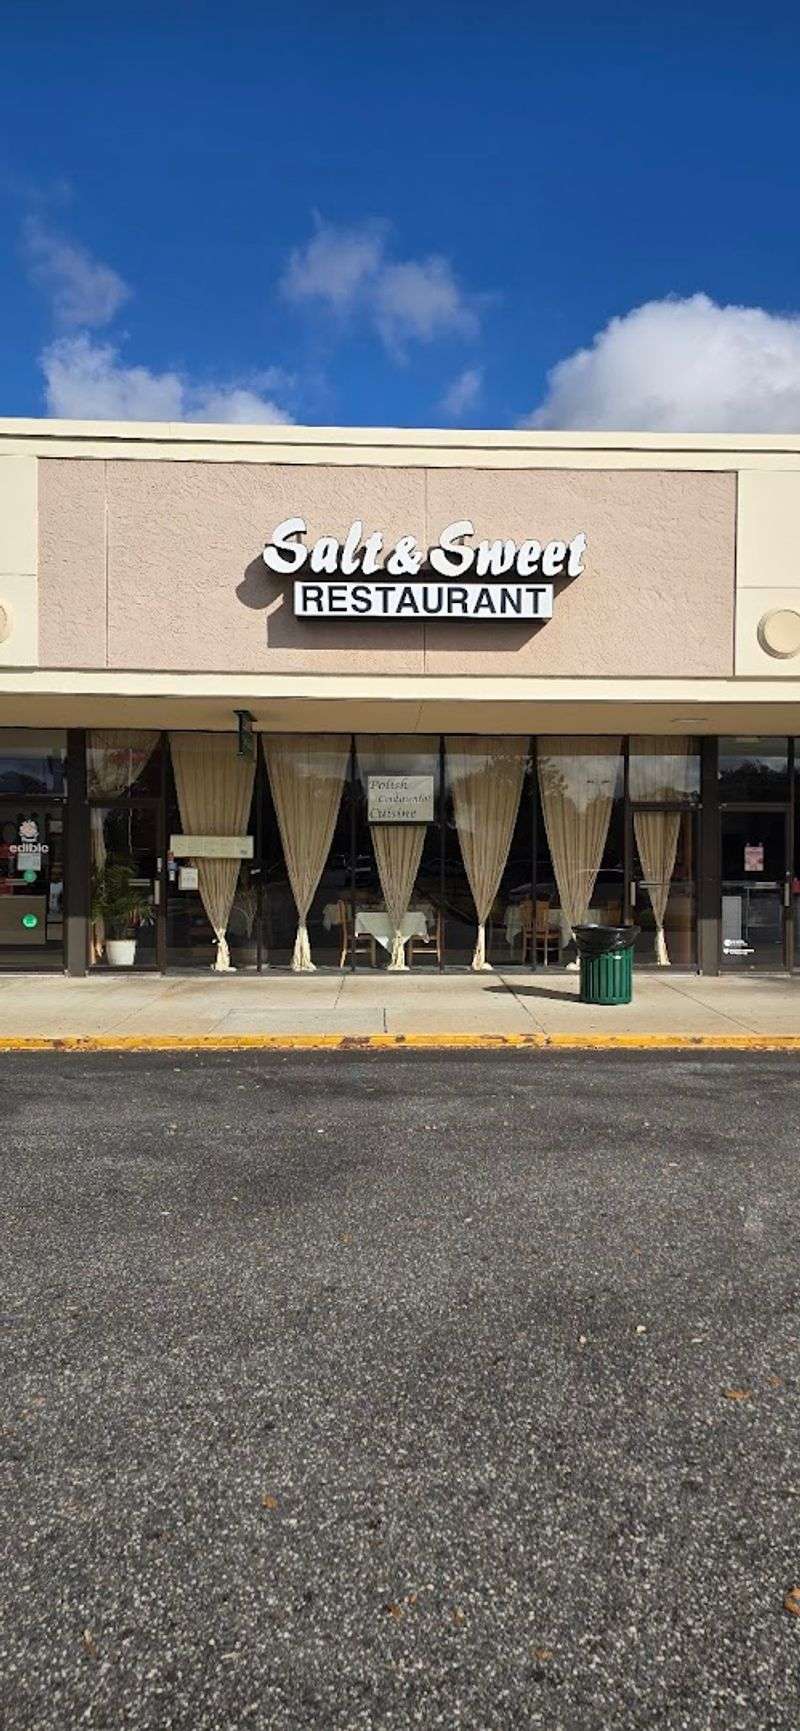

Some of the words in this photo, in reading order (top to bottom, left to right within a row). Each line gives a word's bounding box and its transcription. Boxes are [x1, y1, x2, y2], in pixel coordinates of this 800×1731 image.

[263, 517, 383, 575] Salt
[386, 535, 423, 576] &
[429, 520, 586, 577] Sweet
[302, 585, 546, 614] RESTAURANT
[9, 843, 49, 853] edible
